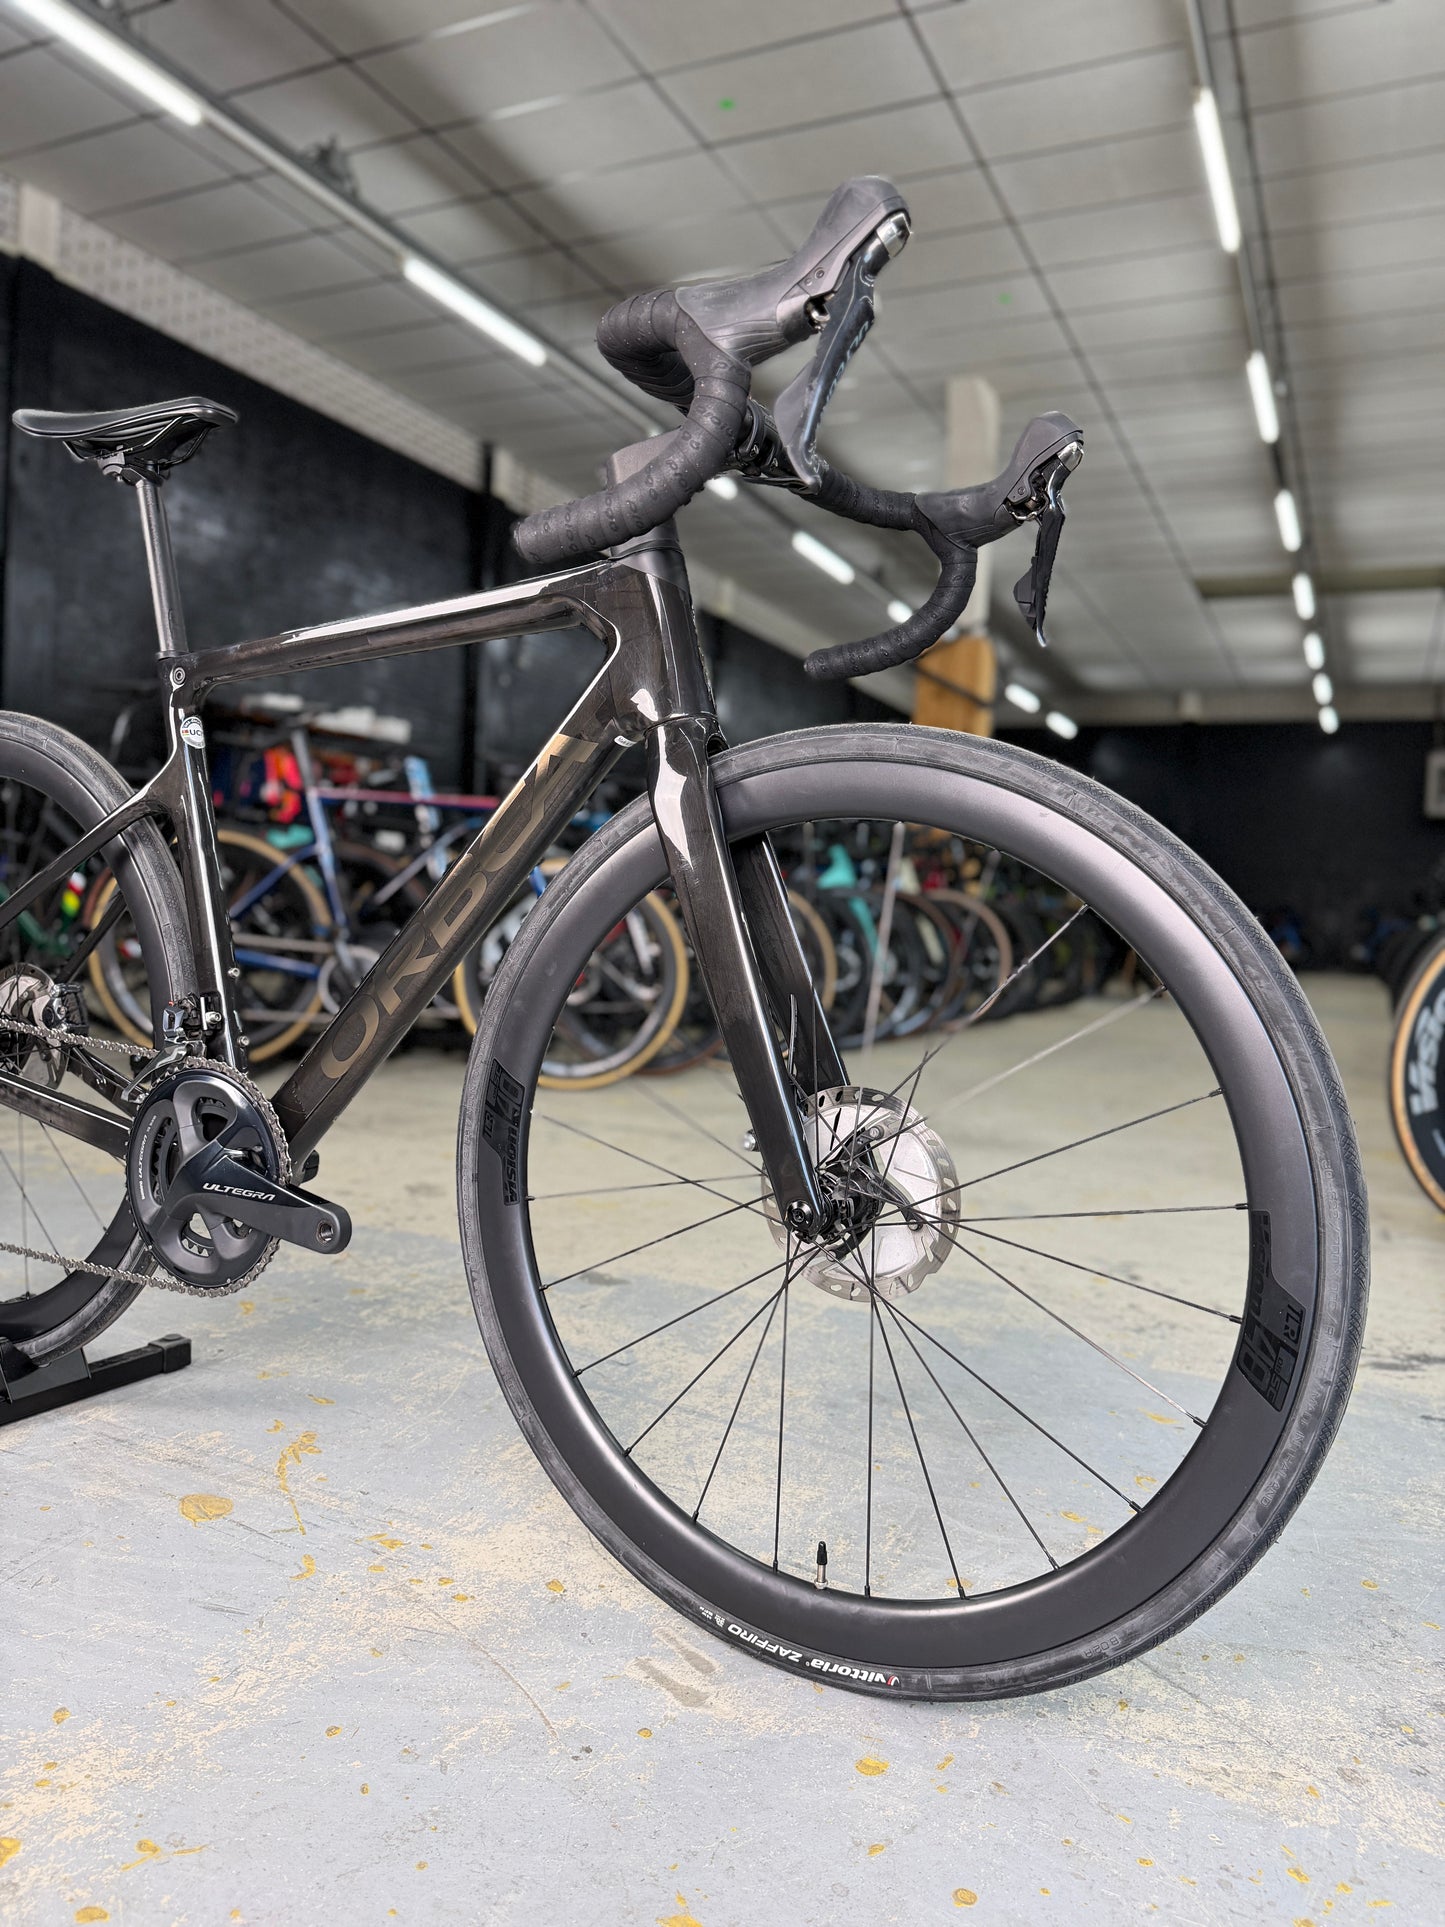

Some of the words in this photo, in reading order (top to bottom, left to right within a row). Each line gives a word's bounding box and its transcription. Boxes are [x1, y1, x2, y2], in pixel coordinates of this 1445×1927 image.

[320, 733, 599, 1080] ORBEA
[202, 1182, 277, 1202] ULTEGRA
[1283, 1303, 1304, 1345] TLR
[727, 1622, 803, 1663] ZAFFIRO
